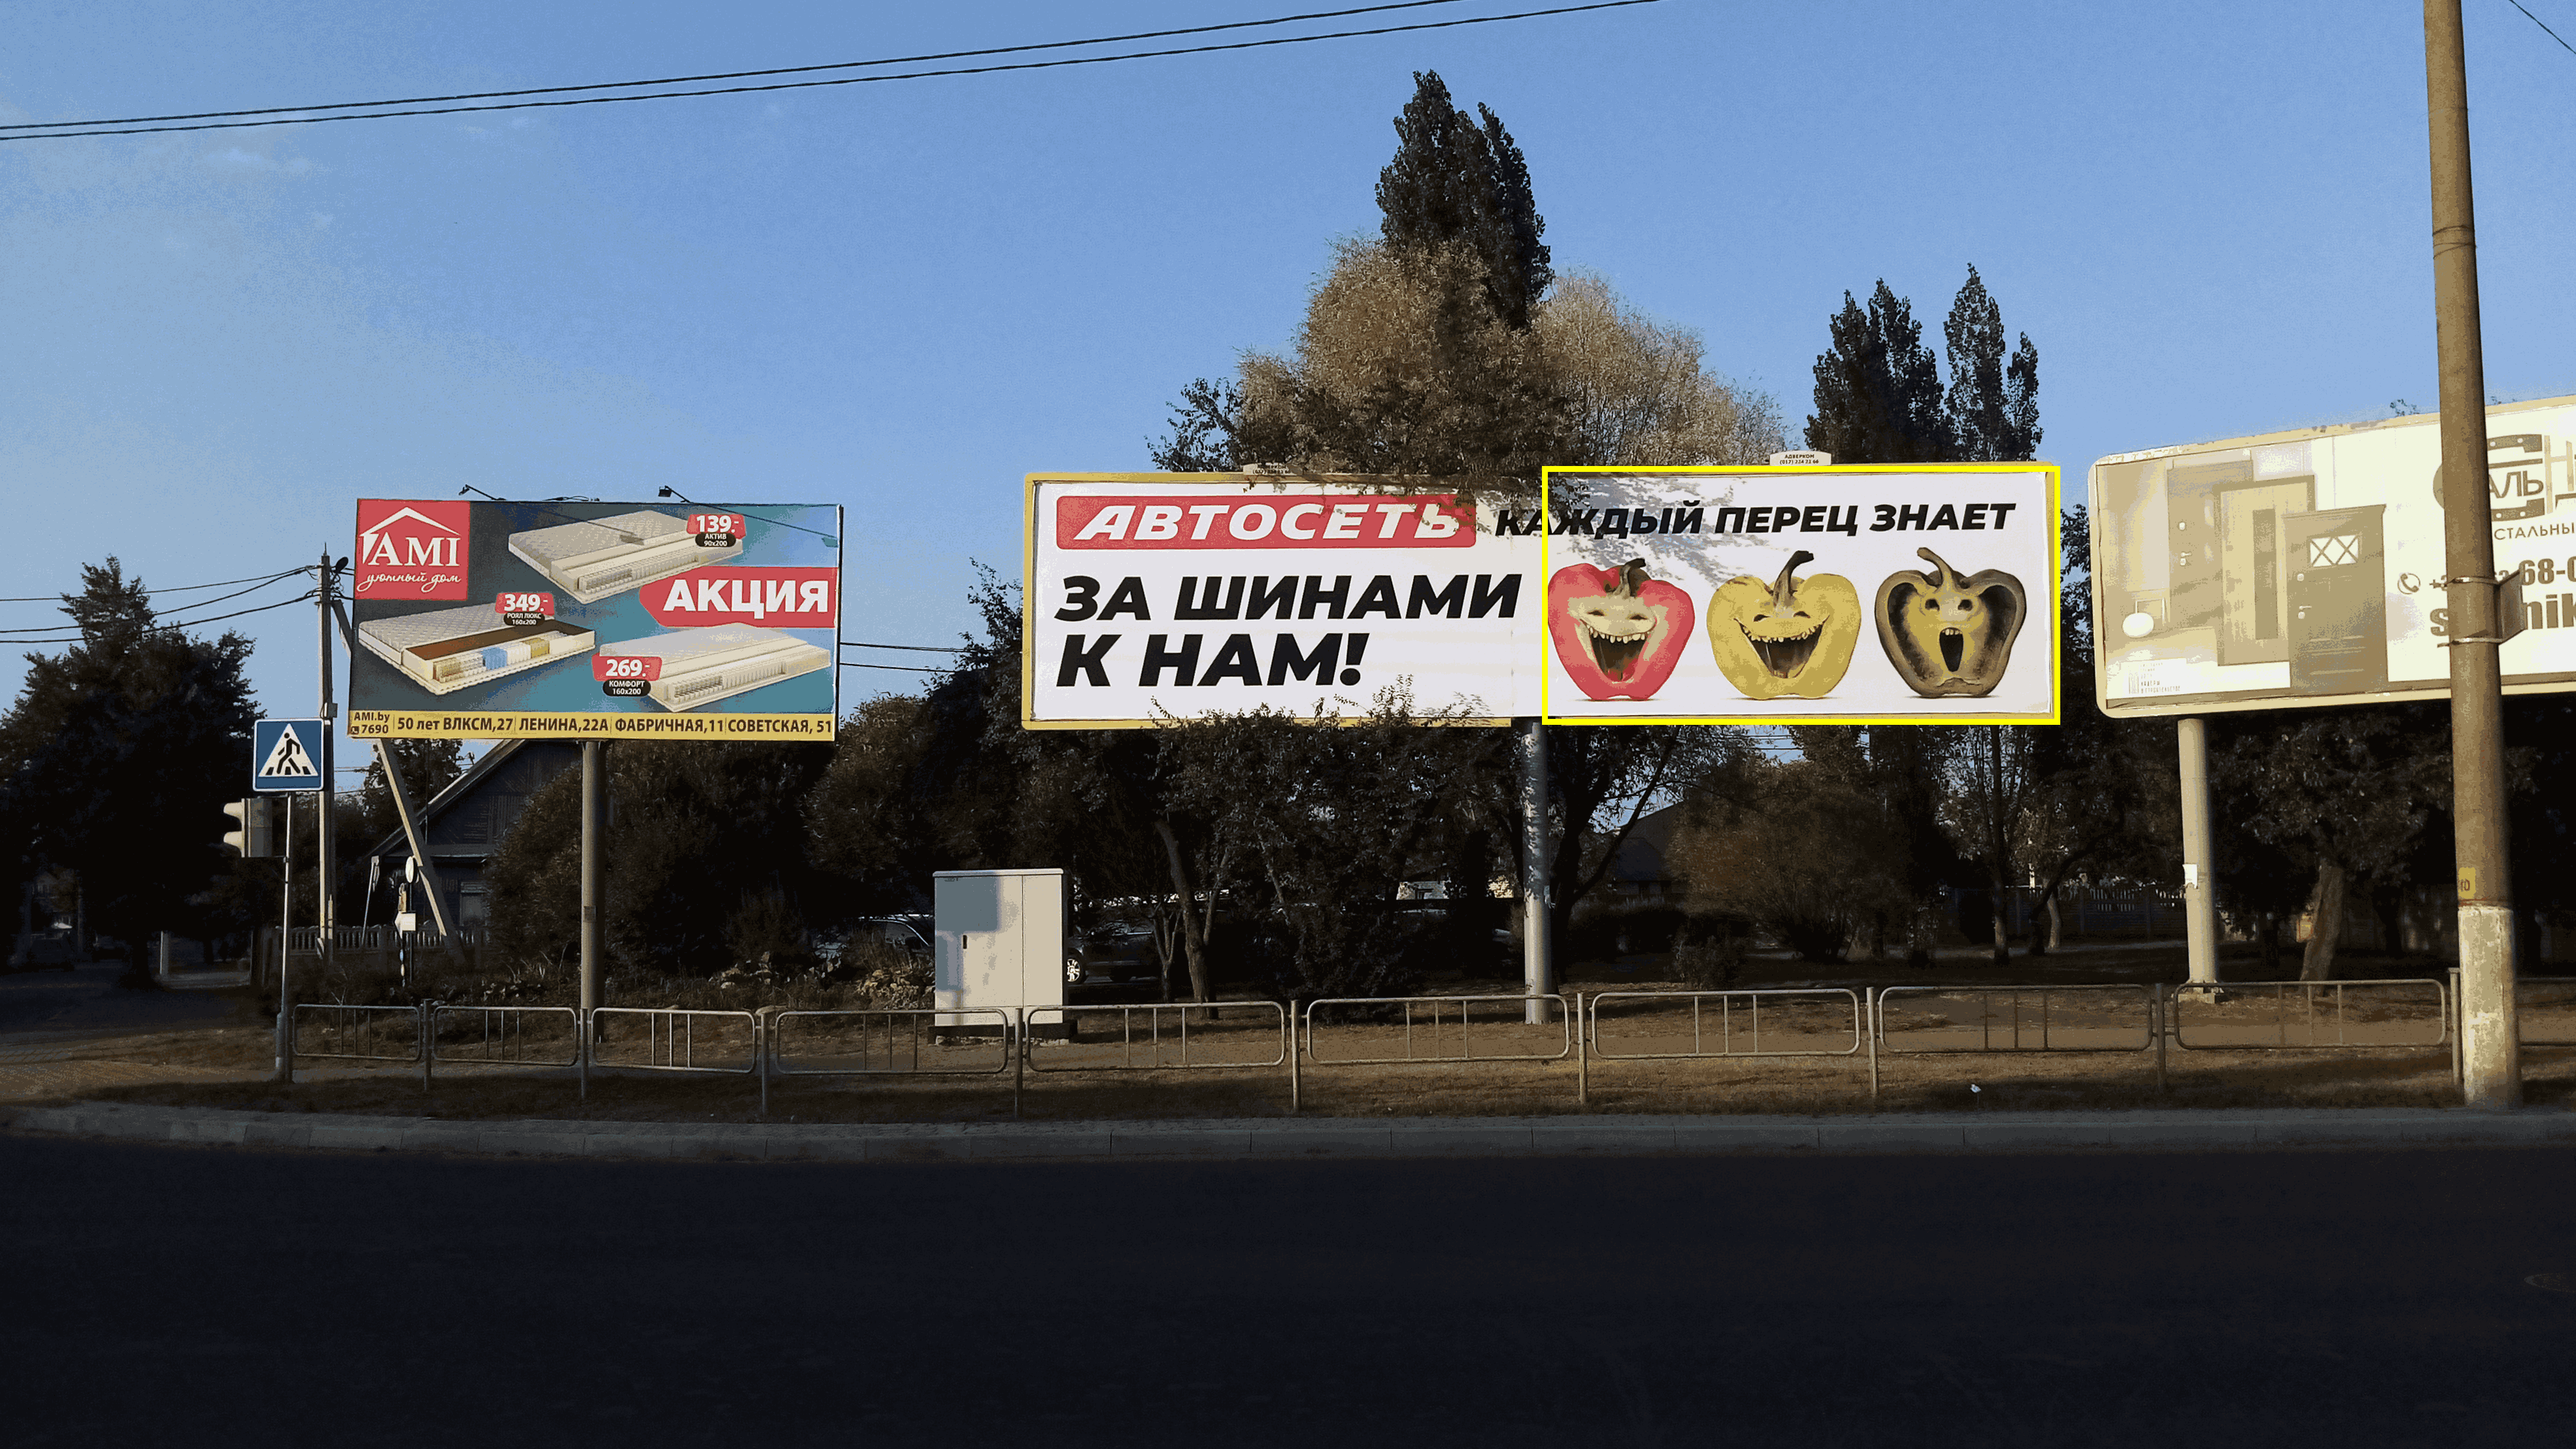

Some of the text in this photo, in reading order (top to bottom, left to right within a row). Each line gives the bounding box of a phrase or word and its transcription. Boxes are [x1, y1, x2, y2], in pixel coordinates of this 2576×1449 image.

[1073, 503, 1462, 541] АВТОСЕТЬ
[1496, 499, 2016, 540] КАЖДЫЙ ПЕРЕЦ ЗНАЕТ
[357, 571, 462, 593] уютный дом
[663, 579, 829, 620] АКЦИЯ
[1054, 574, 1522, 622] ЗА ШИНАМИ
[1056, 633, 1370, 687] К НАМ!
[354, 712, 390, 722] AMI.by
[397, 718, 514, 732] 50 лет ВЛКСМ,27
[519, 718, 609, 733] ЛЕНИНА,22А
[615, 718, 723, 733] ФАБРИЧНАЯ,11
[361, 725, 389, 733] 7690
[728, 719, 831, 735] СОВЕТСКАЯ, 51
